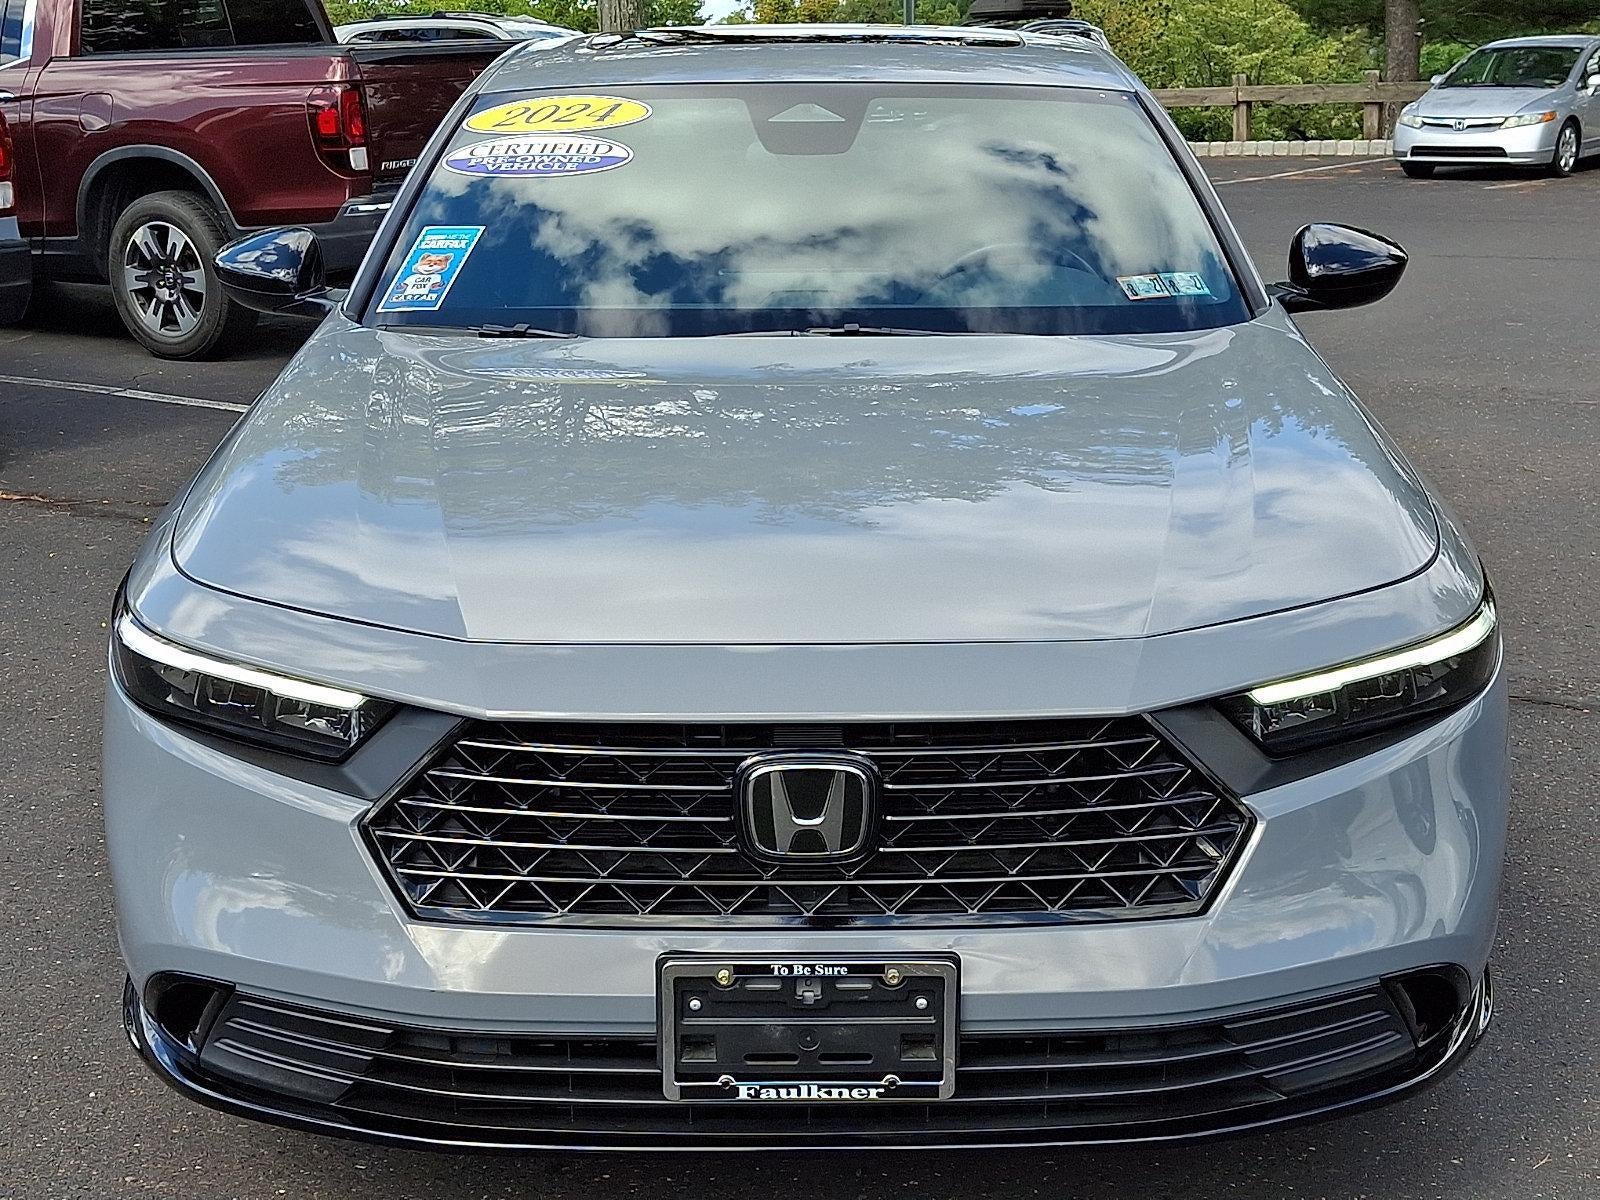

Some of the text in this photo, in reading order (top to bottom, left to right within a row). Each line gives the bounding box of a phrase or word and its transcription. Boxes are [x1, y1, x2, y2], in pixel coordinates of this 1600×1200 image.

[491, 102, 623, 128] 2024
[469, 143, 613, 157] CERTIFIED
[381, 158, 416, 171] RIDGE
[467, 154, 602, 168] PRE-OWNED
[486, 162, 580, 173] VEHICLE
[770, 965, 848, 976] To Be Sure
[735, 1084, 885, 1099] Faulkner
